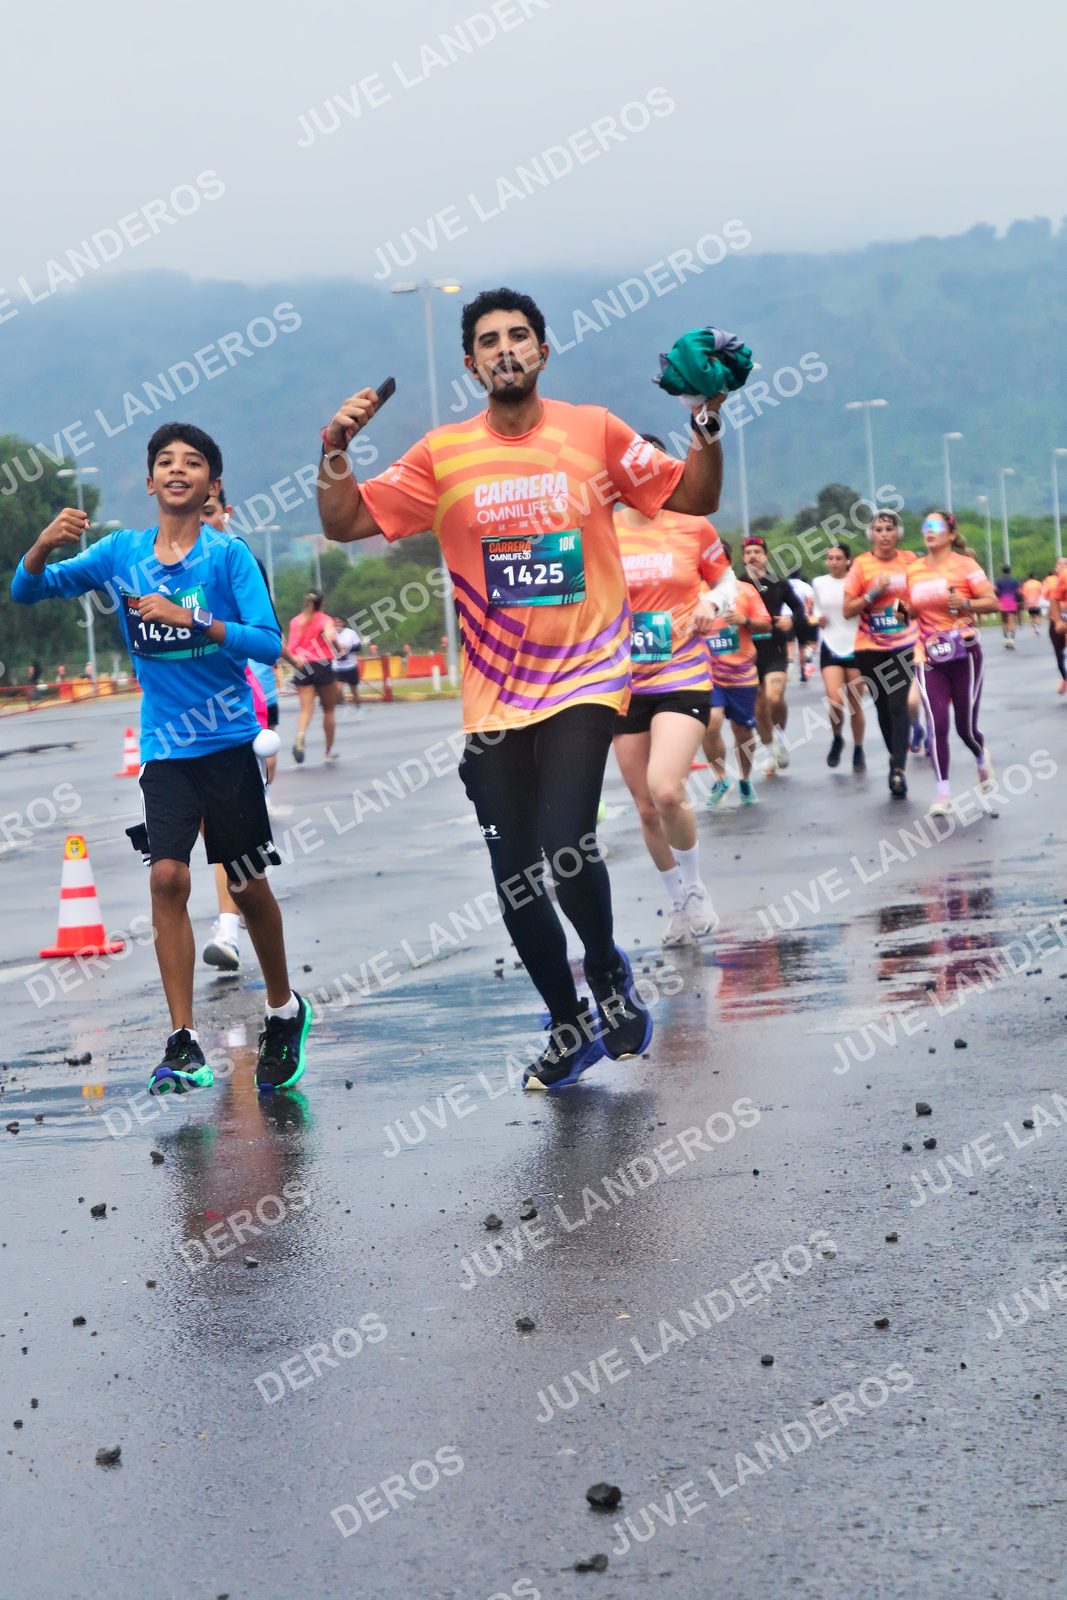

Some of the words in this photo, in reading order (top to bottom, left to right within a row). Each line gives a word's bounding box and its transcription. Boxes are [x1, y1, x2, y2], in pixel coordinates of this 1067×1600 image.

[474, 471, 568, 507] CARRERA
[489, 540, 532, 553] CARRERA
[559, 535, 575, 552] 10K
[503, 562, 564, 586] 1425
[181, 593, 199, 609] 10K
